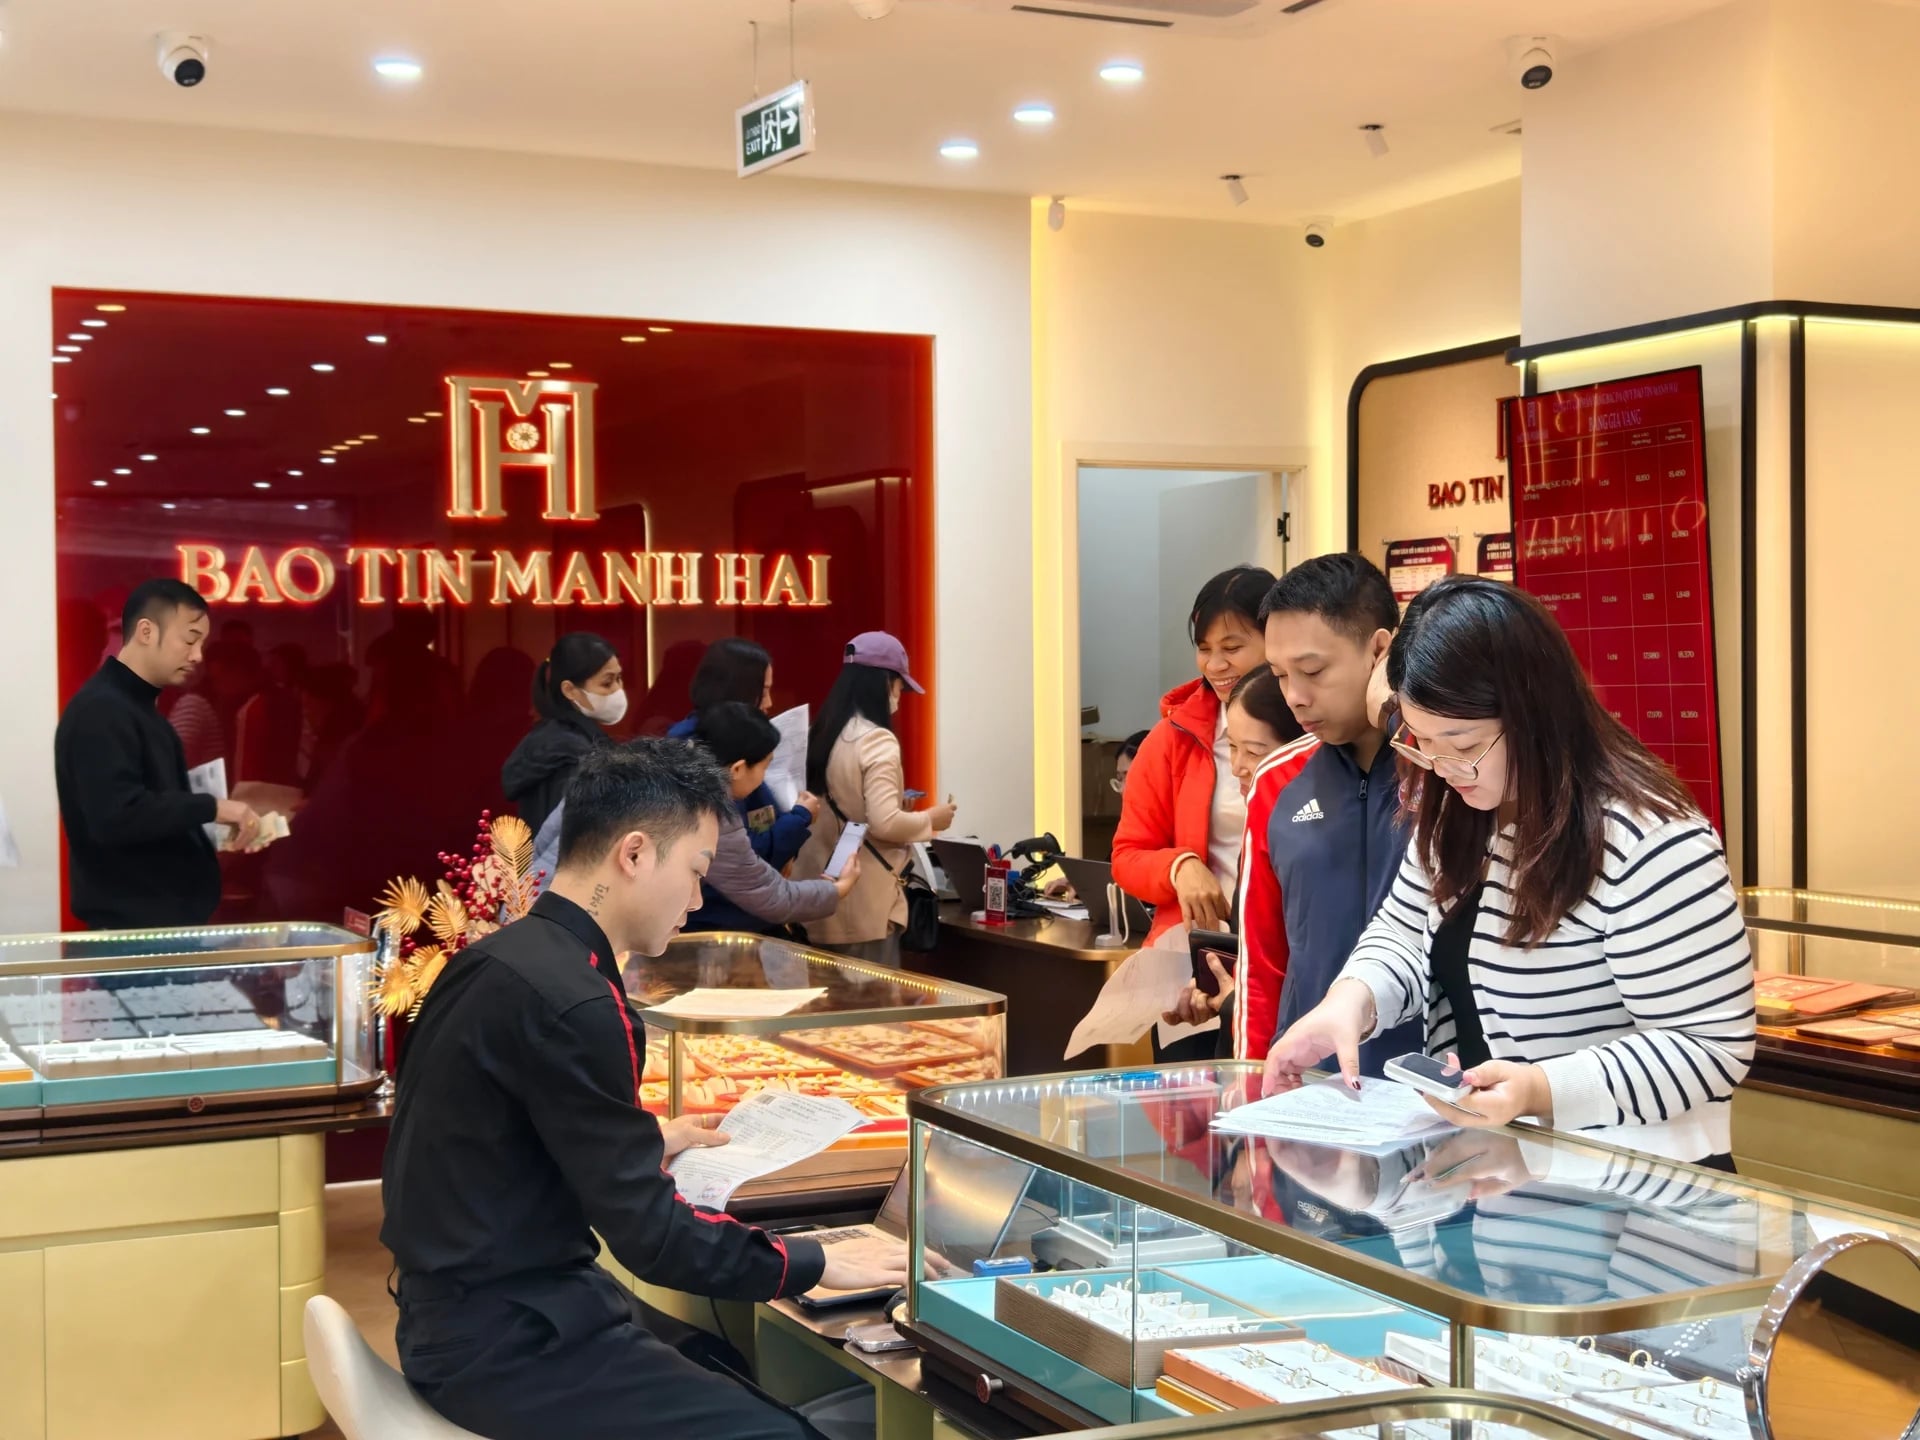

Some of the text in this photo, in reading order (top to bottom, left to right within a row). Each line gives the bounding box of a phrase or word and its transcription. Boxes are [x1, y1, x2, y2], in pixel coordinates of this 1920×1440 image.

[746, 138, 761, 155] EXIT
[1428, 475, 1504, 509] BAO TIN
[177, 545, 832, 606] BAO TIN MANH HAI
[1292, 812, 1324, 822] adidas
